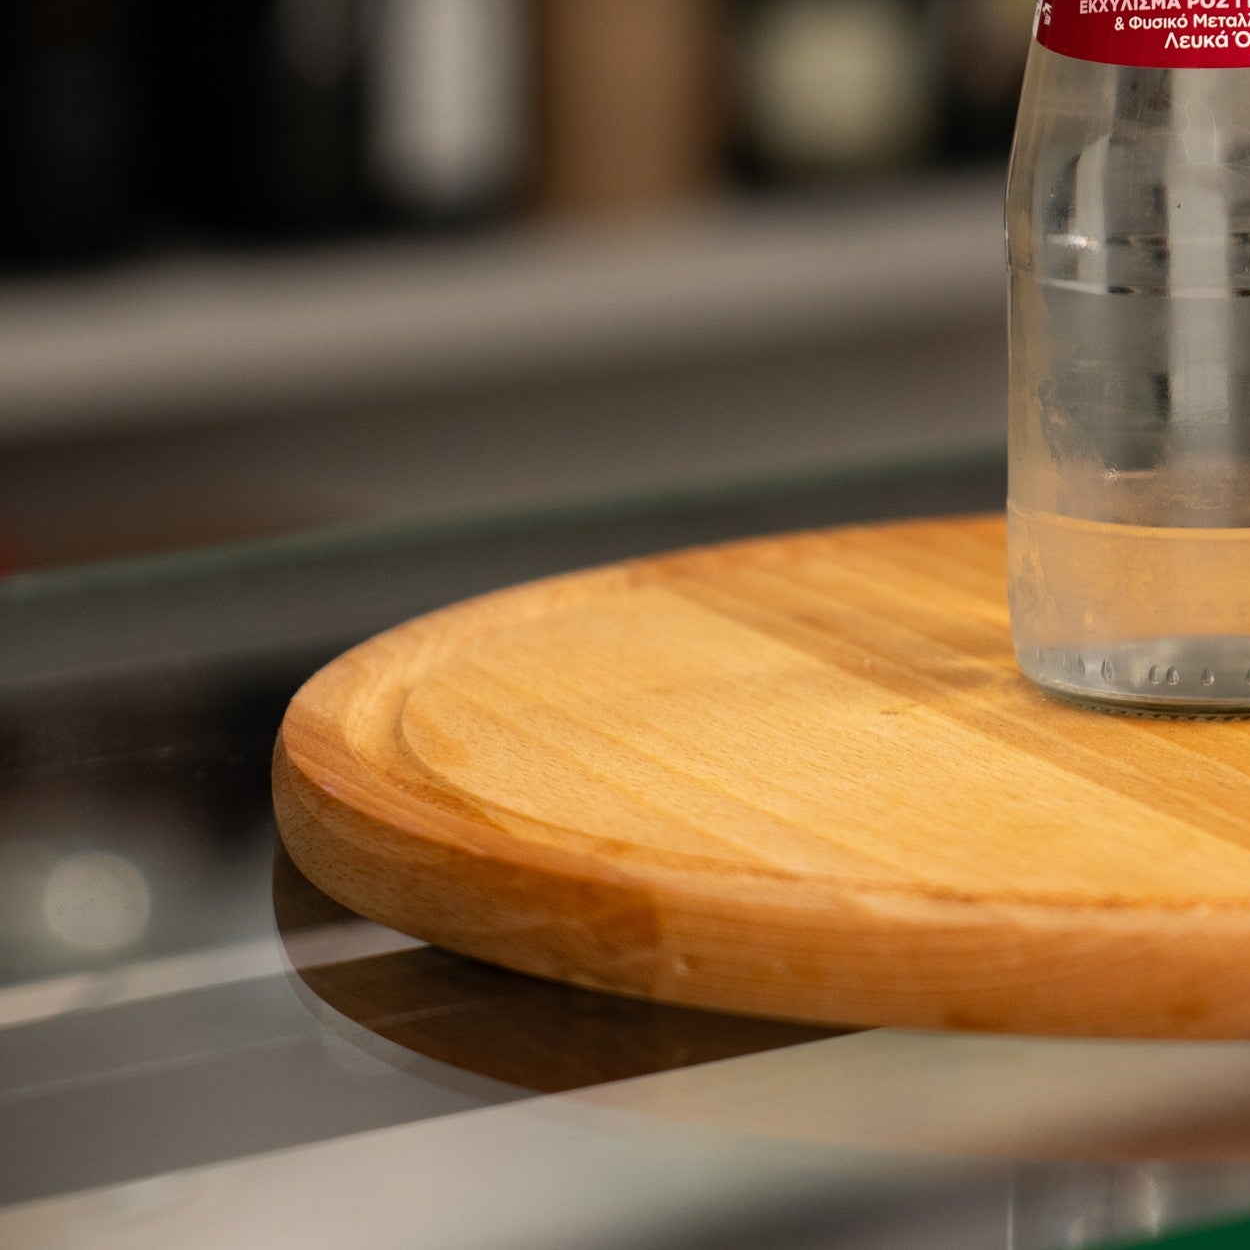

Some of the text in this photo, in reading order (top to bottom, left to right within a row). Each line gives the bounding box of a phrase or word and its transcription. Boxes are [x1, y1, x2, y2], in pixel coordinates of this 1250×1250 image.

[1114, 16, 1125, 31] &
[1128, 13, 1188, 30] Φυσικό
[1164, 29, 1229, 49] Λευκά
